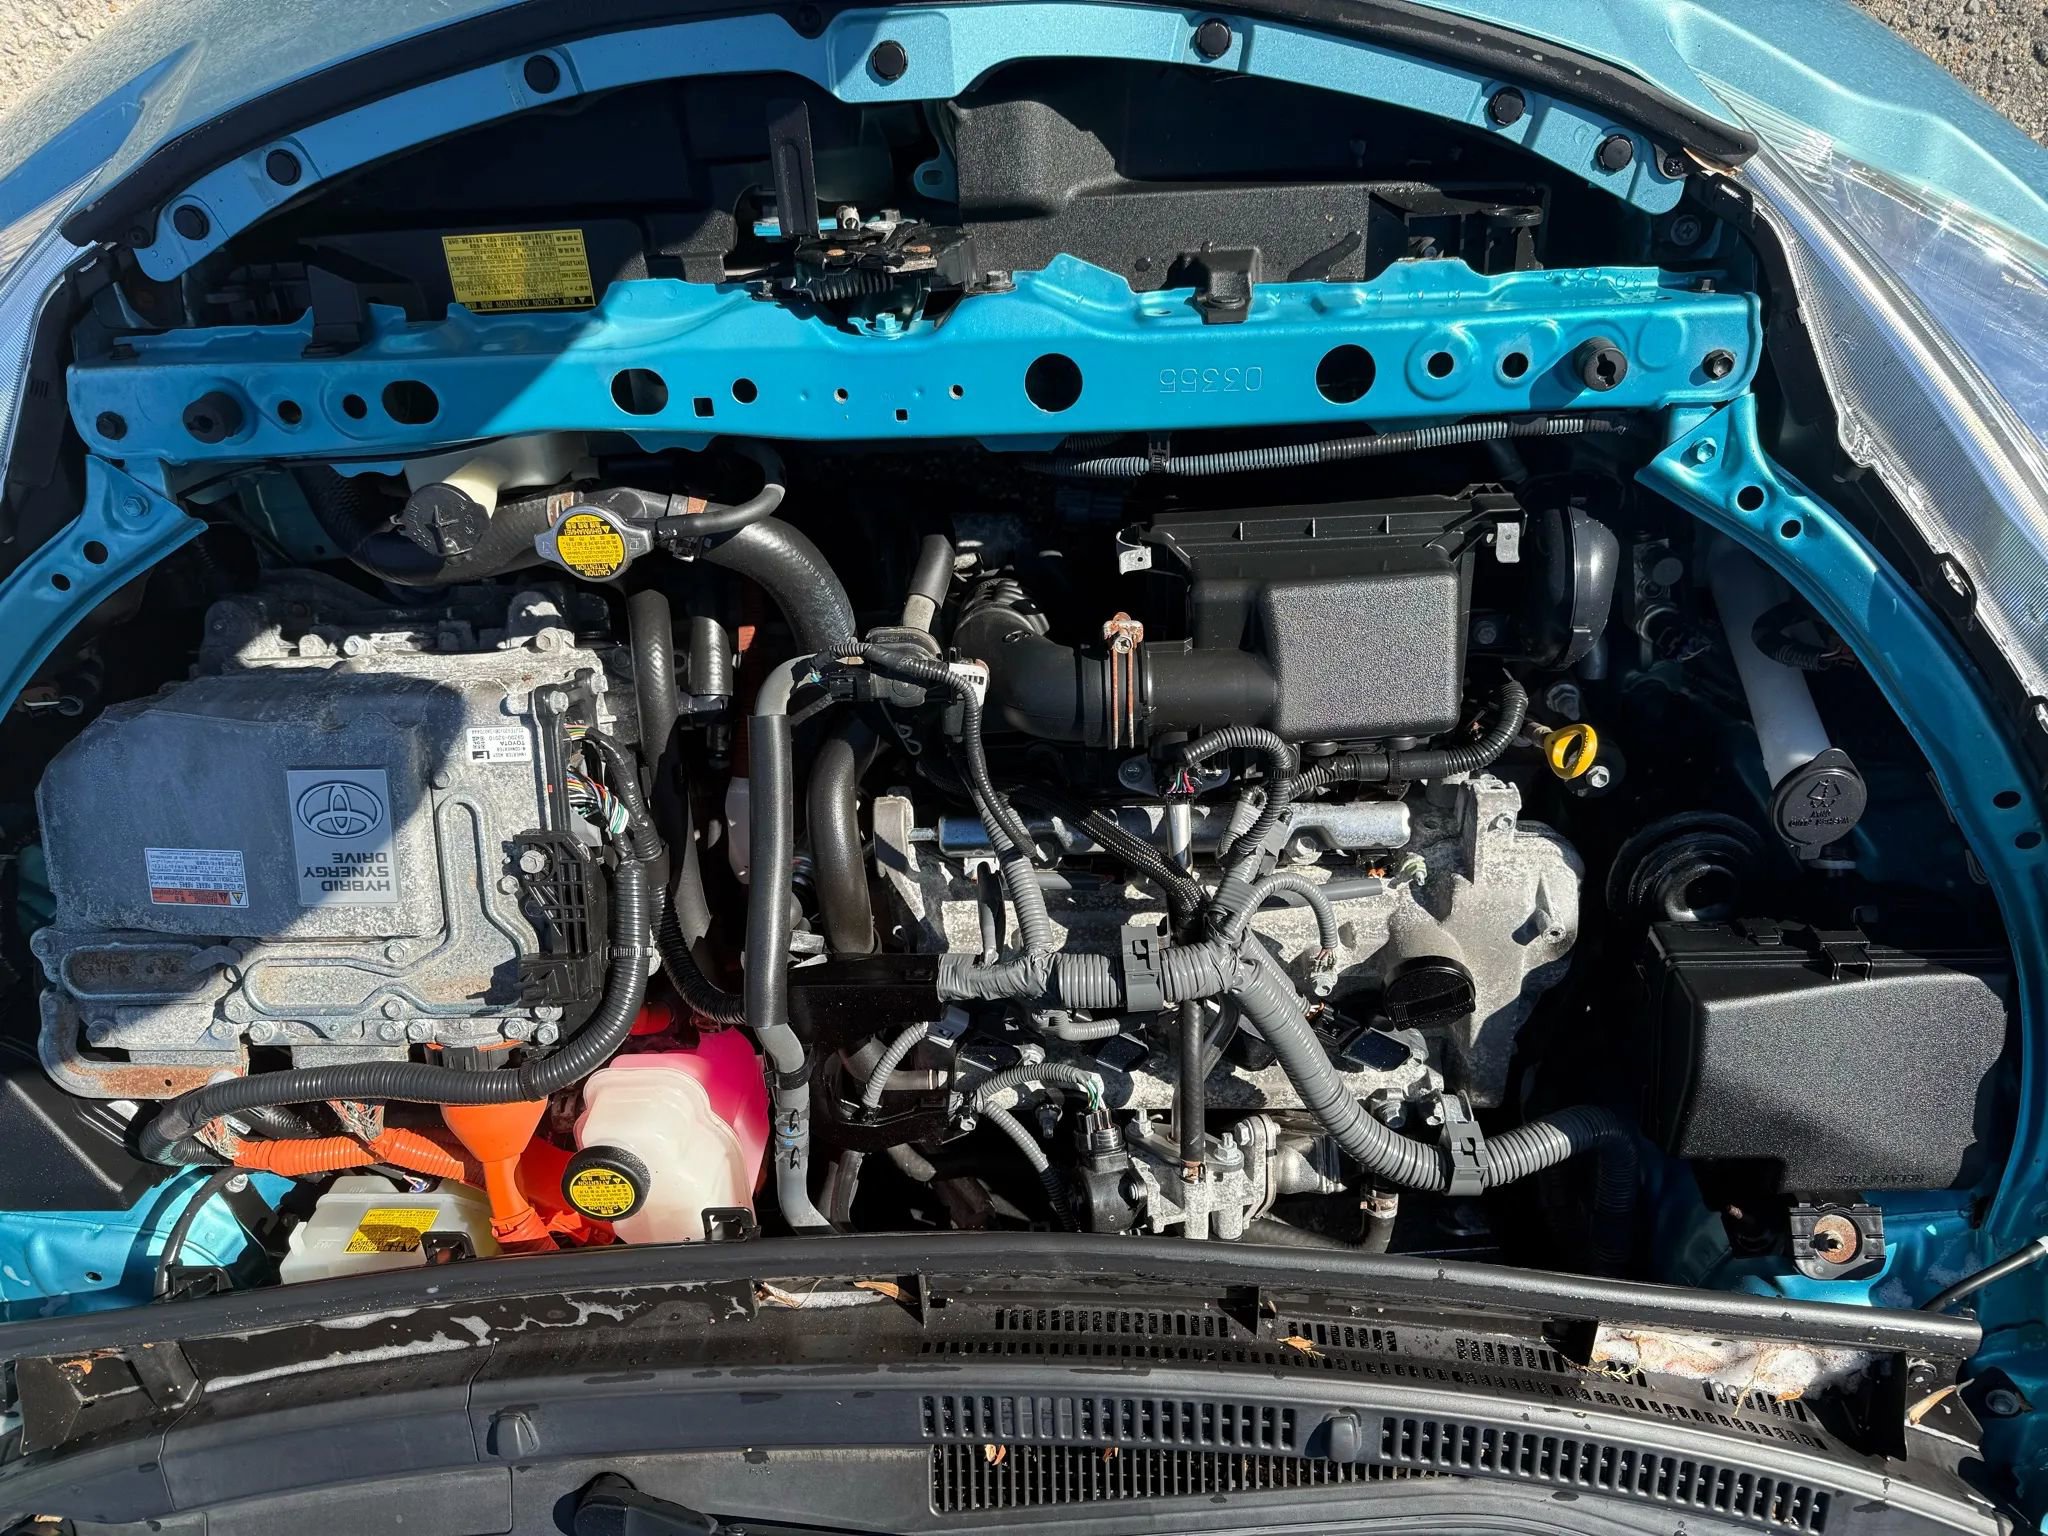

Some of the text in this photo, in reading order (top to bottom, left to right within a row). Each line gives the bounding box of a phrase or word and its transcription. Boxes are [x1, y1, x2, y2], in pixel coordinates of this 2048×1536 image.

[496, 300, 529, 308] ATTENTION
[532, 298, 560, 306] CAUTION
[1159, 366, 1262, 393] 03355
[332, 853, 388, 863] DRIVE
[303, 866, 389, 878] SYNERGY
[321, 880, 390, 892] HYBRID
